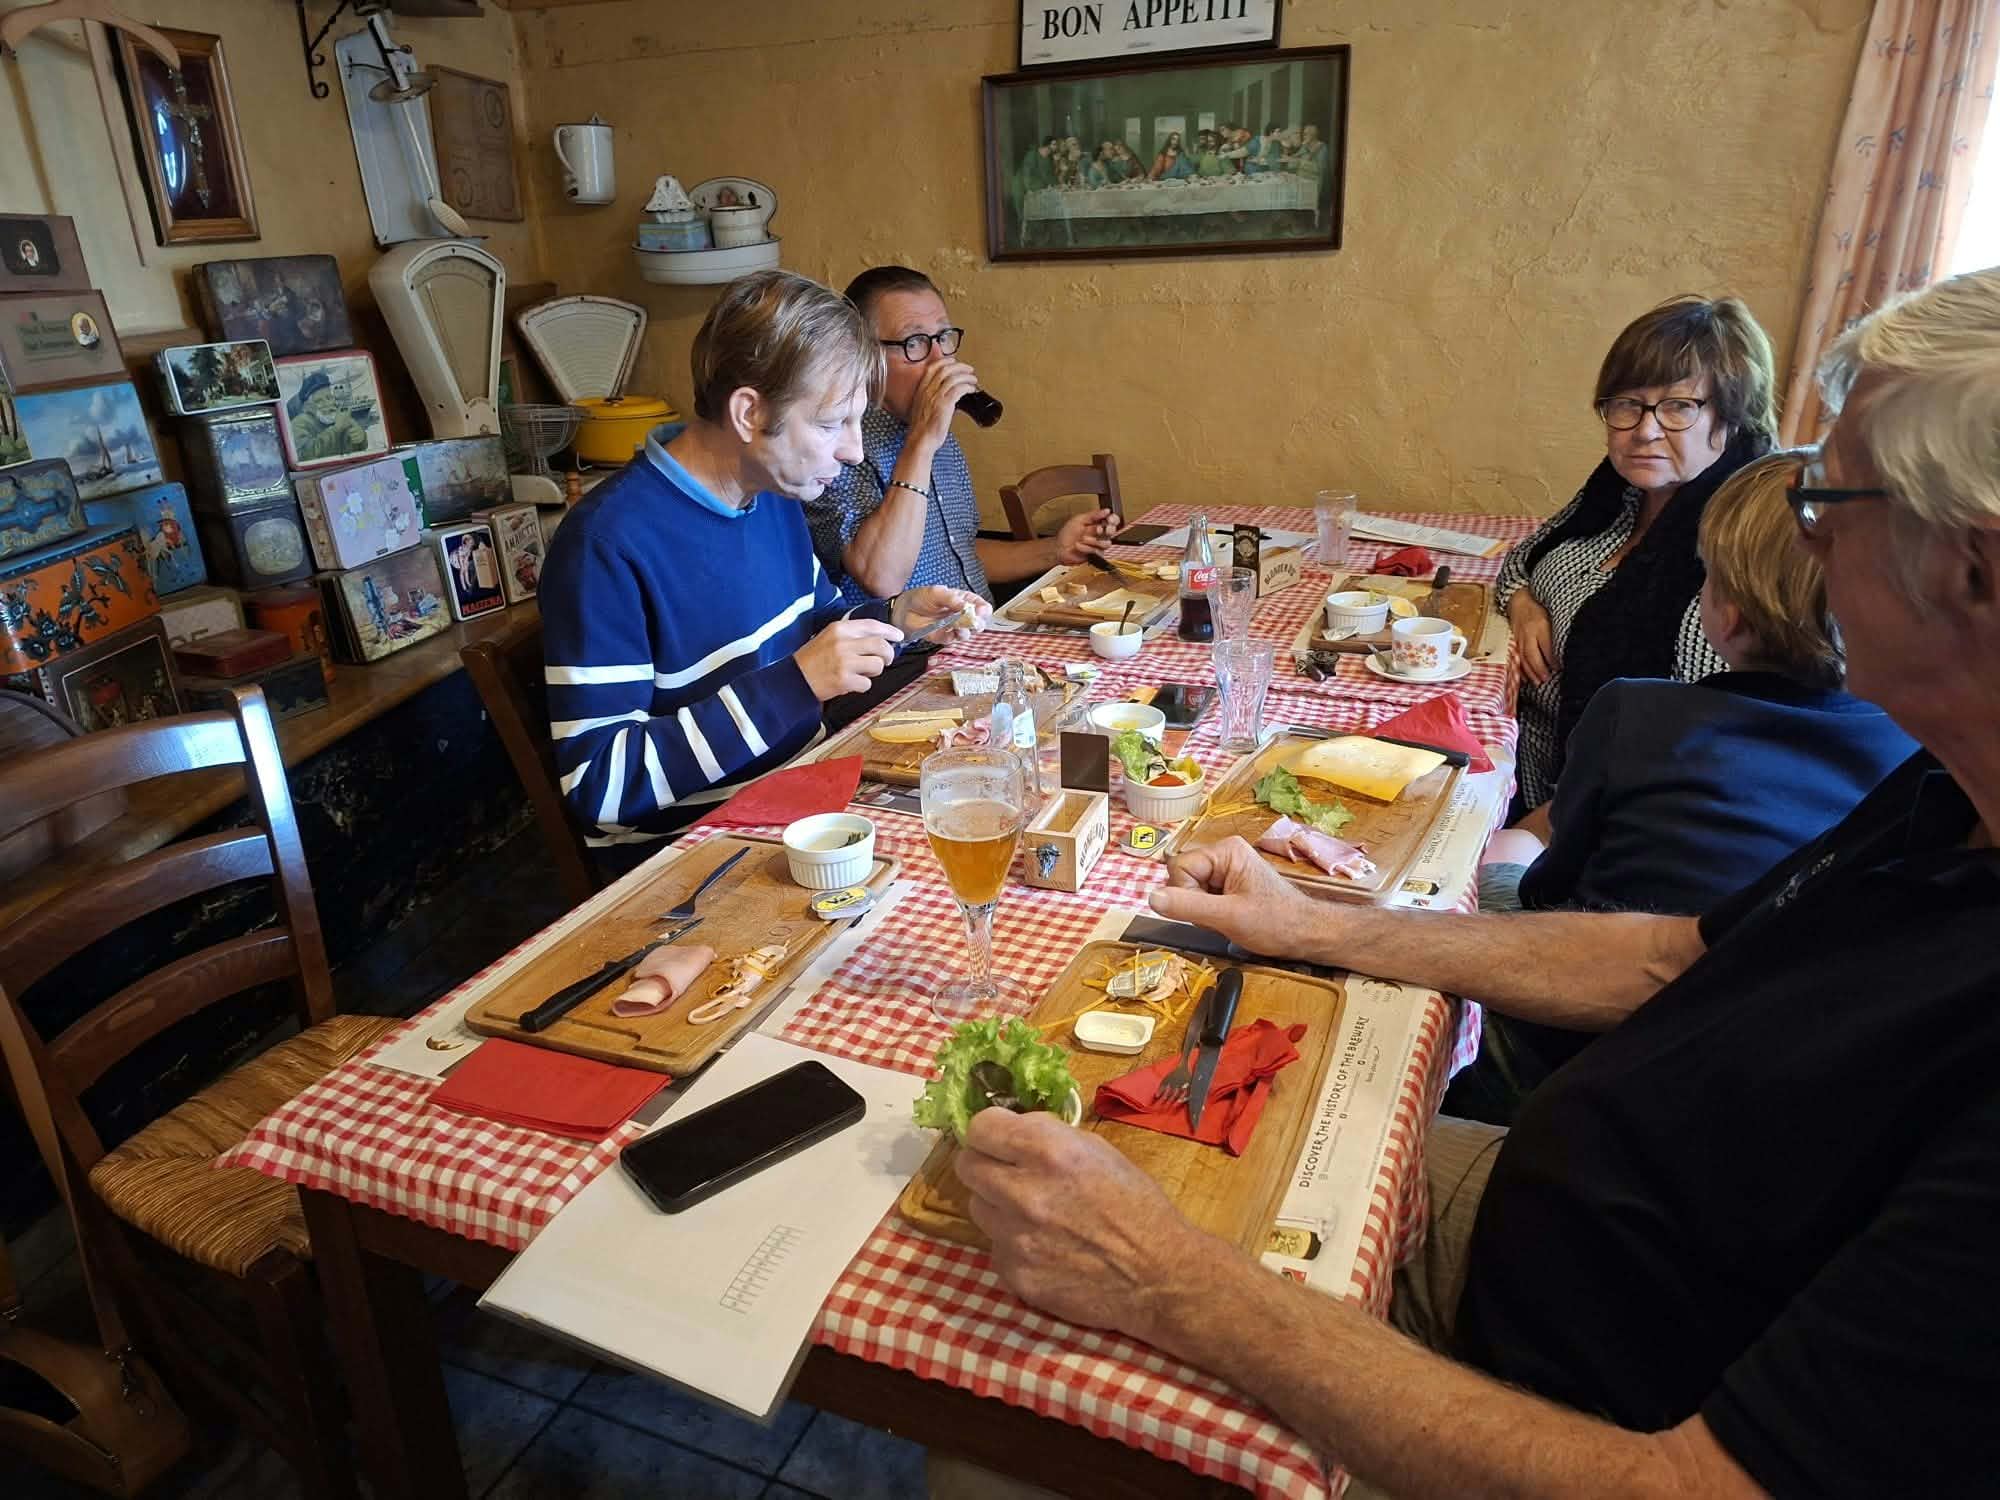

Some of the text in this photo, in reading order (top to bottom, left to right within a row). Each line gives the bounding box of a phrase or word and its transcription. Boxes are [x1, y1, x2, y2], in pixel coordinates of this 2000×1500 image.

[1042, 4, 1104, 40] BON
[1347, 1015, 1369, 1051] BREWERY
[1336, 1069, 1348, 1081] OF
[1341, 1052, 1354, 1067] THE
[1322, 1081, 1346, 1118] HISTORY
[1314, 1119, 1331, 1136] THE
[1298, 1136, 1328, 1188] DISCOVER
